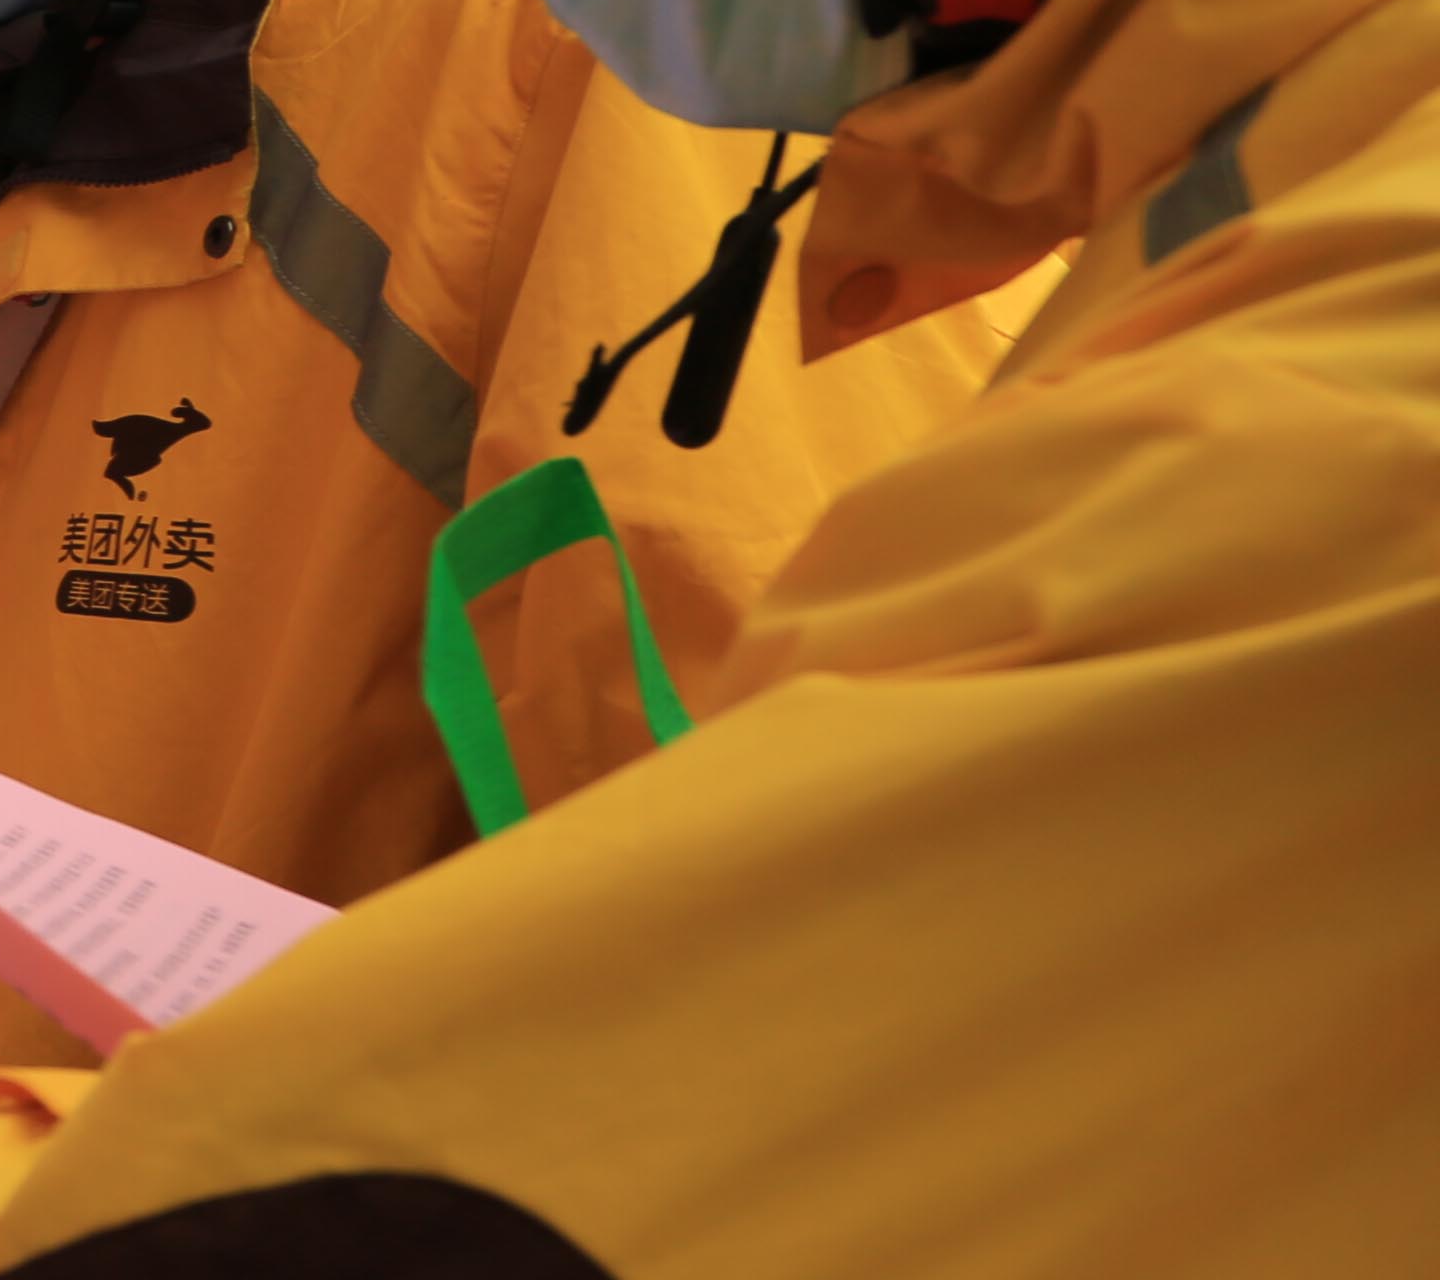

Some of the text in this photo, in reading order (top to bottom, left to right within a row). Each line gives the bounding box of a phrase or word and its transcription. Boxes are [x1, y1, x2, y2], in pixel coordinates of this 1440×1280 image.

[57, 513, 216, 572] 美团外卖
[66, 578, 172, 618] 美团专送
